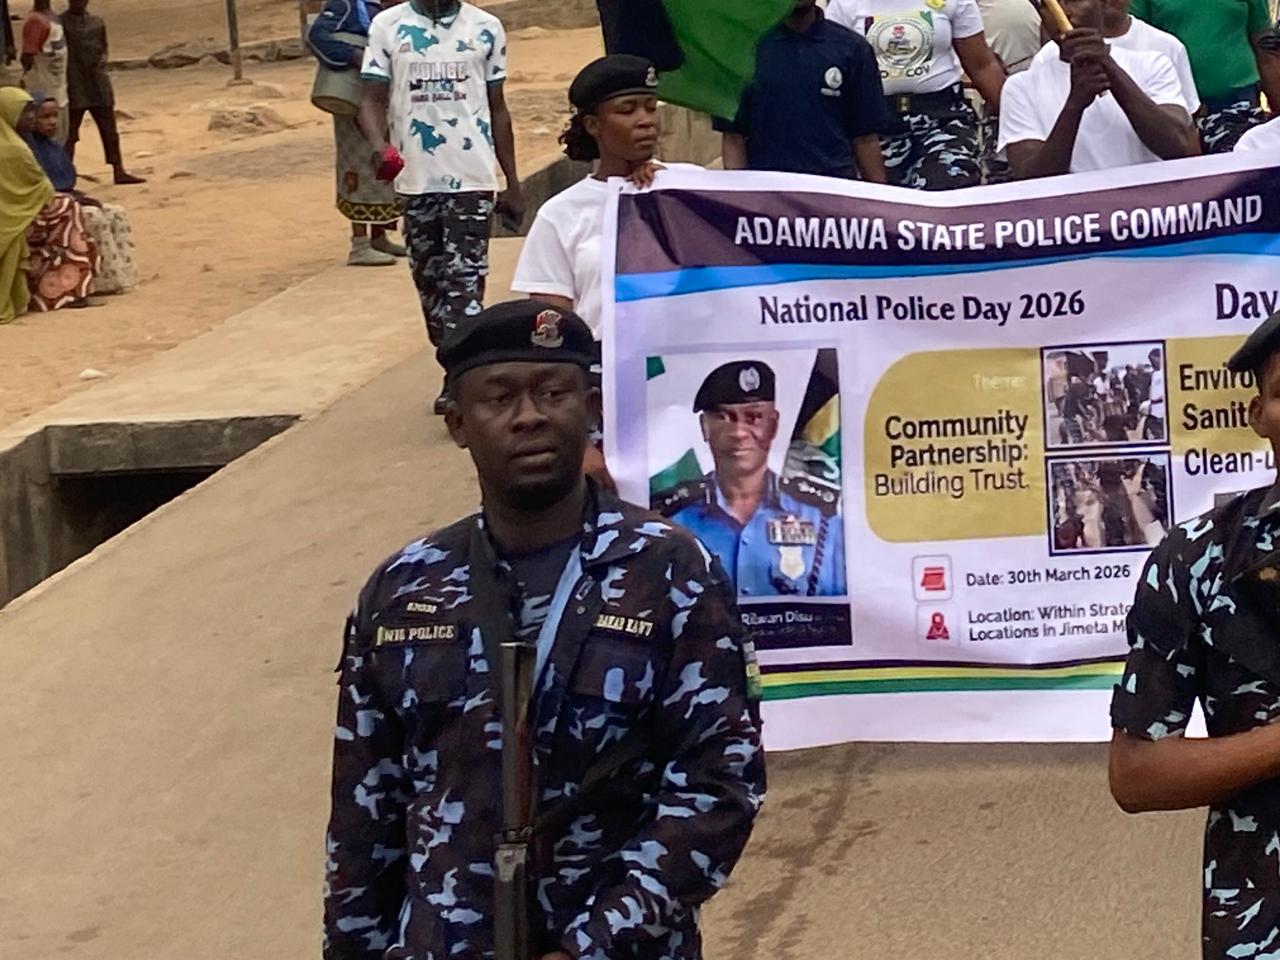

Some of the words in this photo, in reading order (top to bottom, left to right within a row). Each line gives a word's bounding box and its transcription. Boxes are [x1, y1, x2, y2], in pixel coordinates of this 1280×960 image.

[735, 216, 888, 250] ADAMAWA
[897, 220, 985, 251] STATE
[994, 213, 1101, 248] POLICE
[1110, 195, 1262, 241] COMMAND
[759, 294, 868, 325] National
[876, 295, 954, 321] Police
[963, 295, 1011, 326] Day
[1019, 290, 1085, 320] 2026
[1215, 283, 1278, 320] Day
[885, 409, 1028, 440] Community
[891, 439, 1028, 468] Partnership:
[875, 471, 964, 499] Building
[969, 468, 1030, 491] Trust.
[966, 573, 1003, 586] Date:
[1008, 569, 1041, 584] 30th
[1045, 566, 1090, 582] March
[1094, 564, 1131, 580] 2026
[968, 607, 1035, 624] Location:
[1037, 604, 1086, 620] Within
[408, 625, 455, 640] POLICE
[969, 625, 1039, 641] Locations
[1043, 623, 1056, 637] in
[1059, 620, 1108, 636] Jimeta
